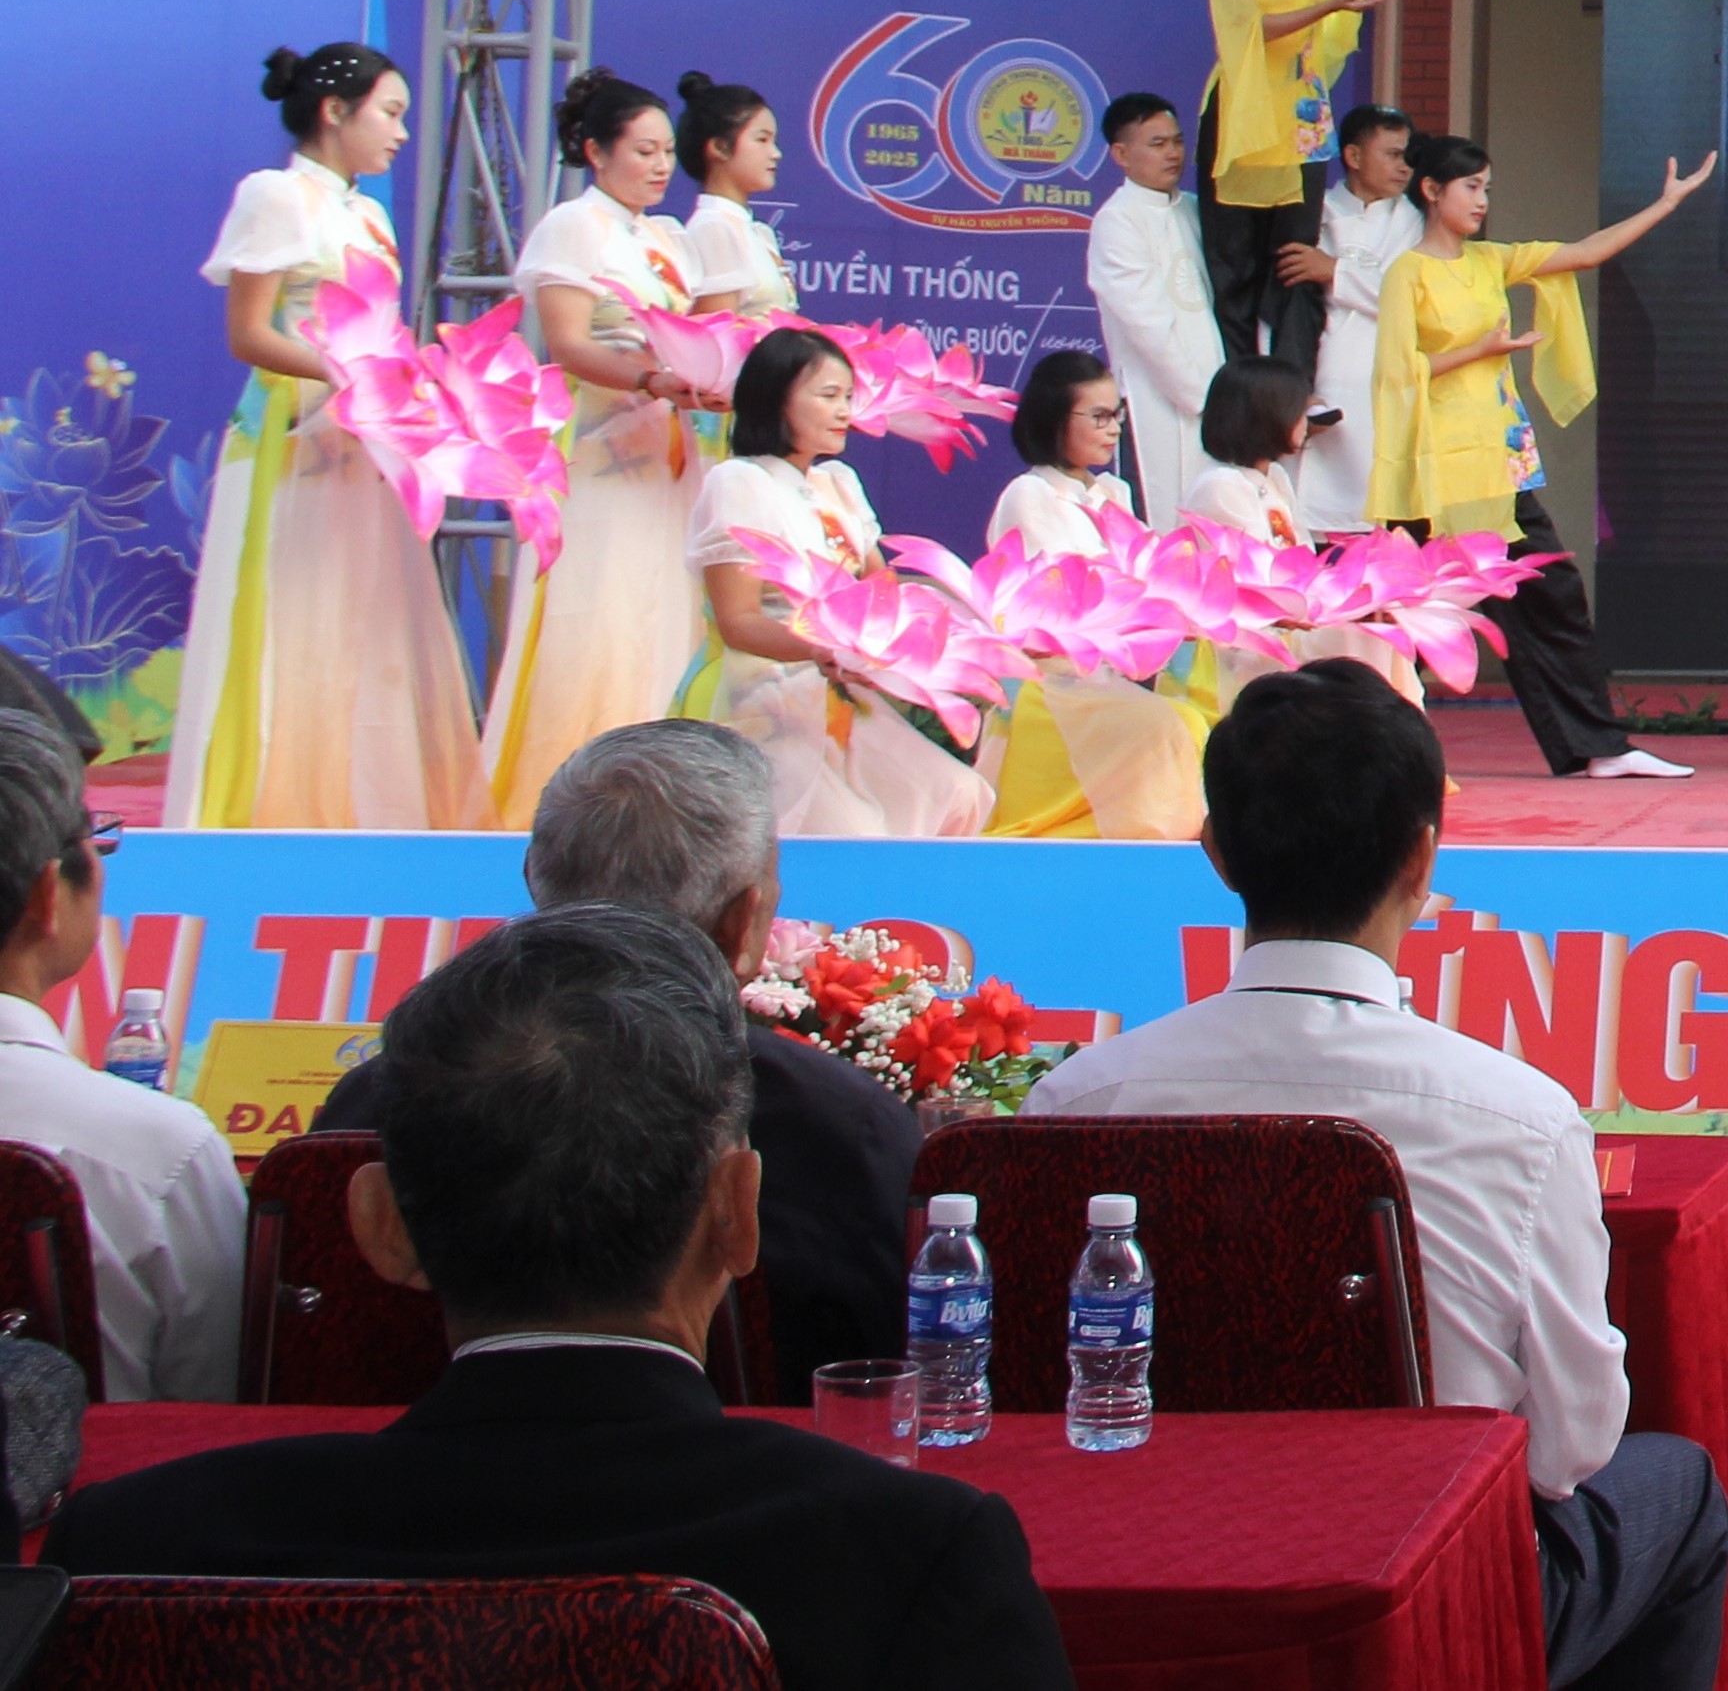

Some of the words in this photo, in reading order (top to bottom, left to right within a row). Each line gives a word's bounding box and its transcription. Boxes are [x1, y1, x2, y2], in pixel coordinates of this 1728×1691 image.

[866, 123, 920, 143] 1965
[864, 149, 919, 168] 2025
[1023, 183, 1092, 207] Năm
[903, 256, 1021, 302] THỐNG
[966, 322, 1028, 356] BƯỚC
